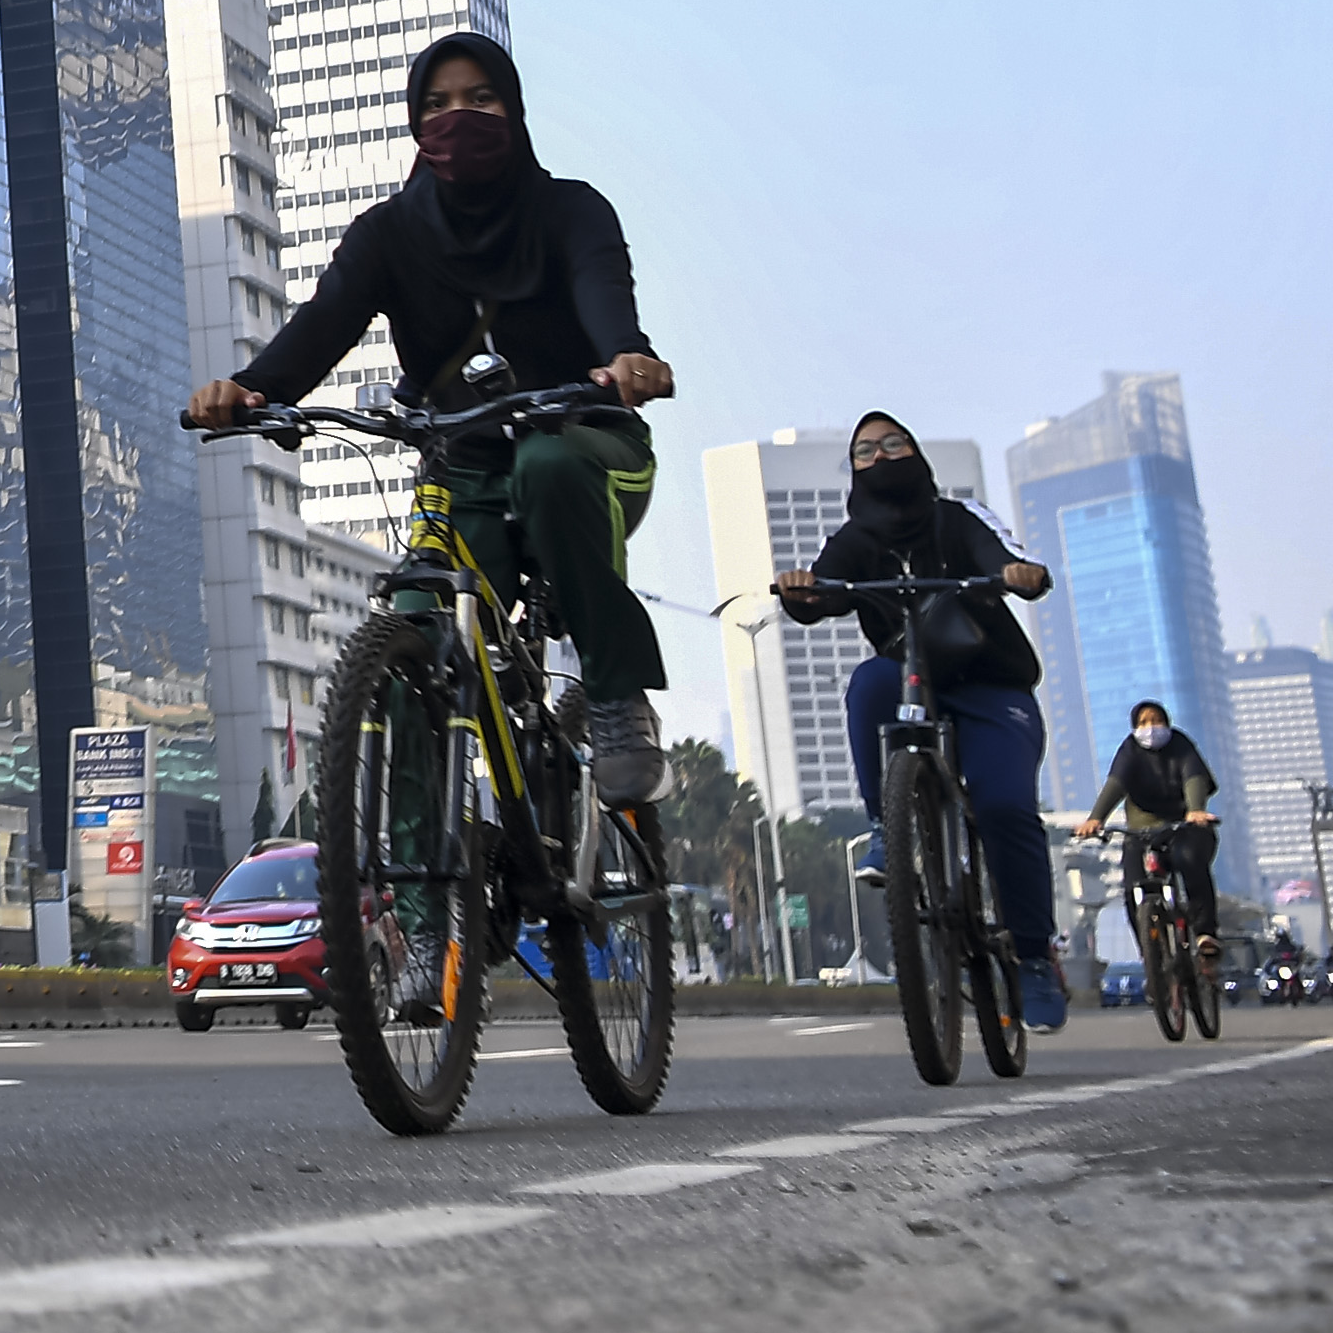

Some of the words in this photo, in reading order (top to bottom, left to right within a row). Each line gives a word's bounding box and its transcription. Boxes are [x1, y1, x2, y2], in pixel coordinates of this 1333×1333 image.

[88, 734, 129, 748] PLAZA
[76, 749, 108, 761] BANK
[109, 747, 145, 760] INDEX
